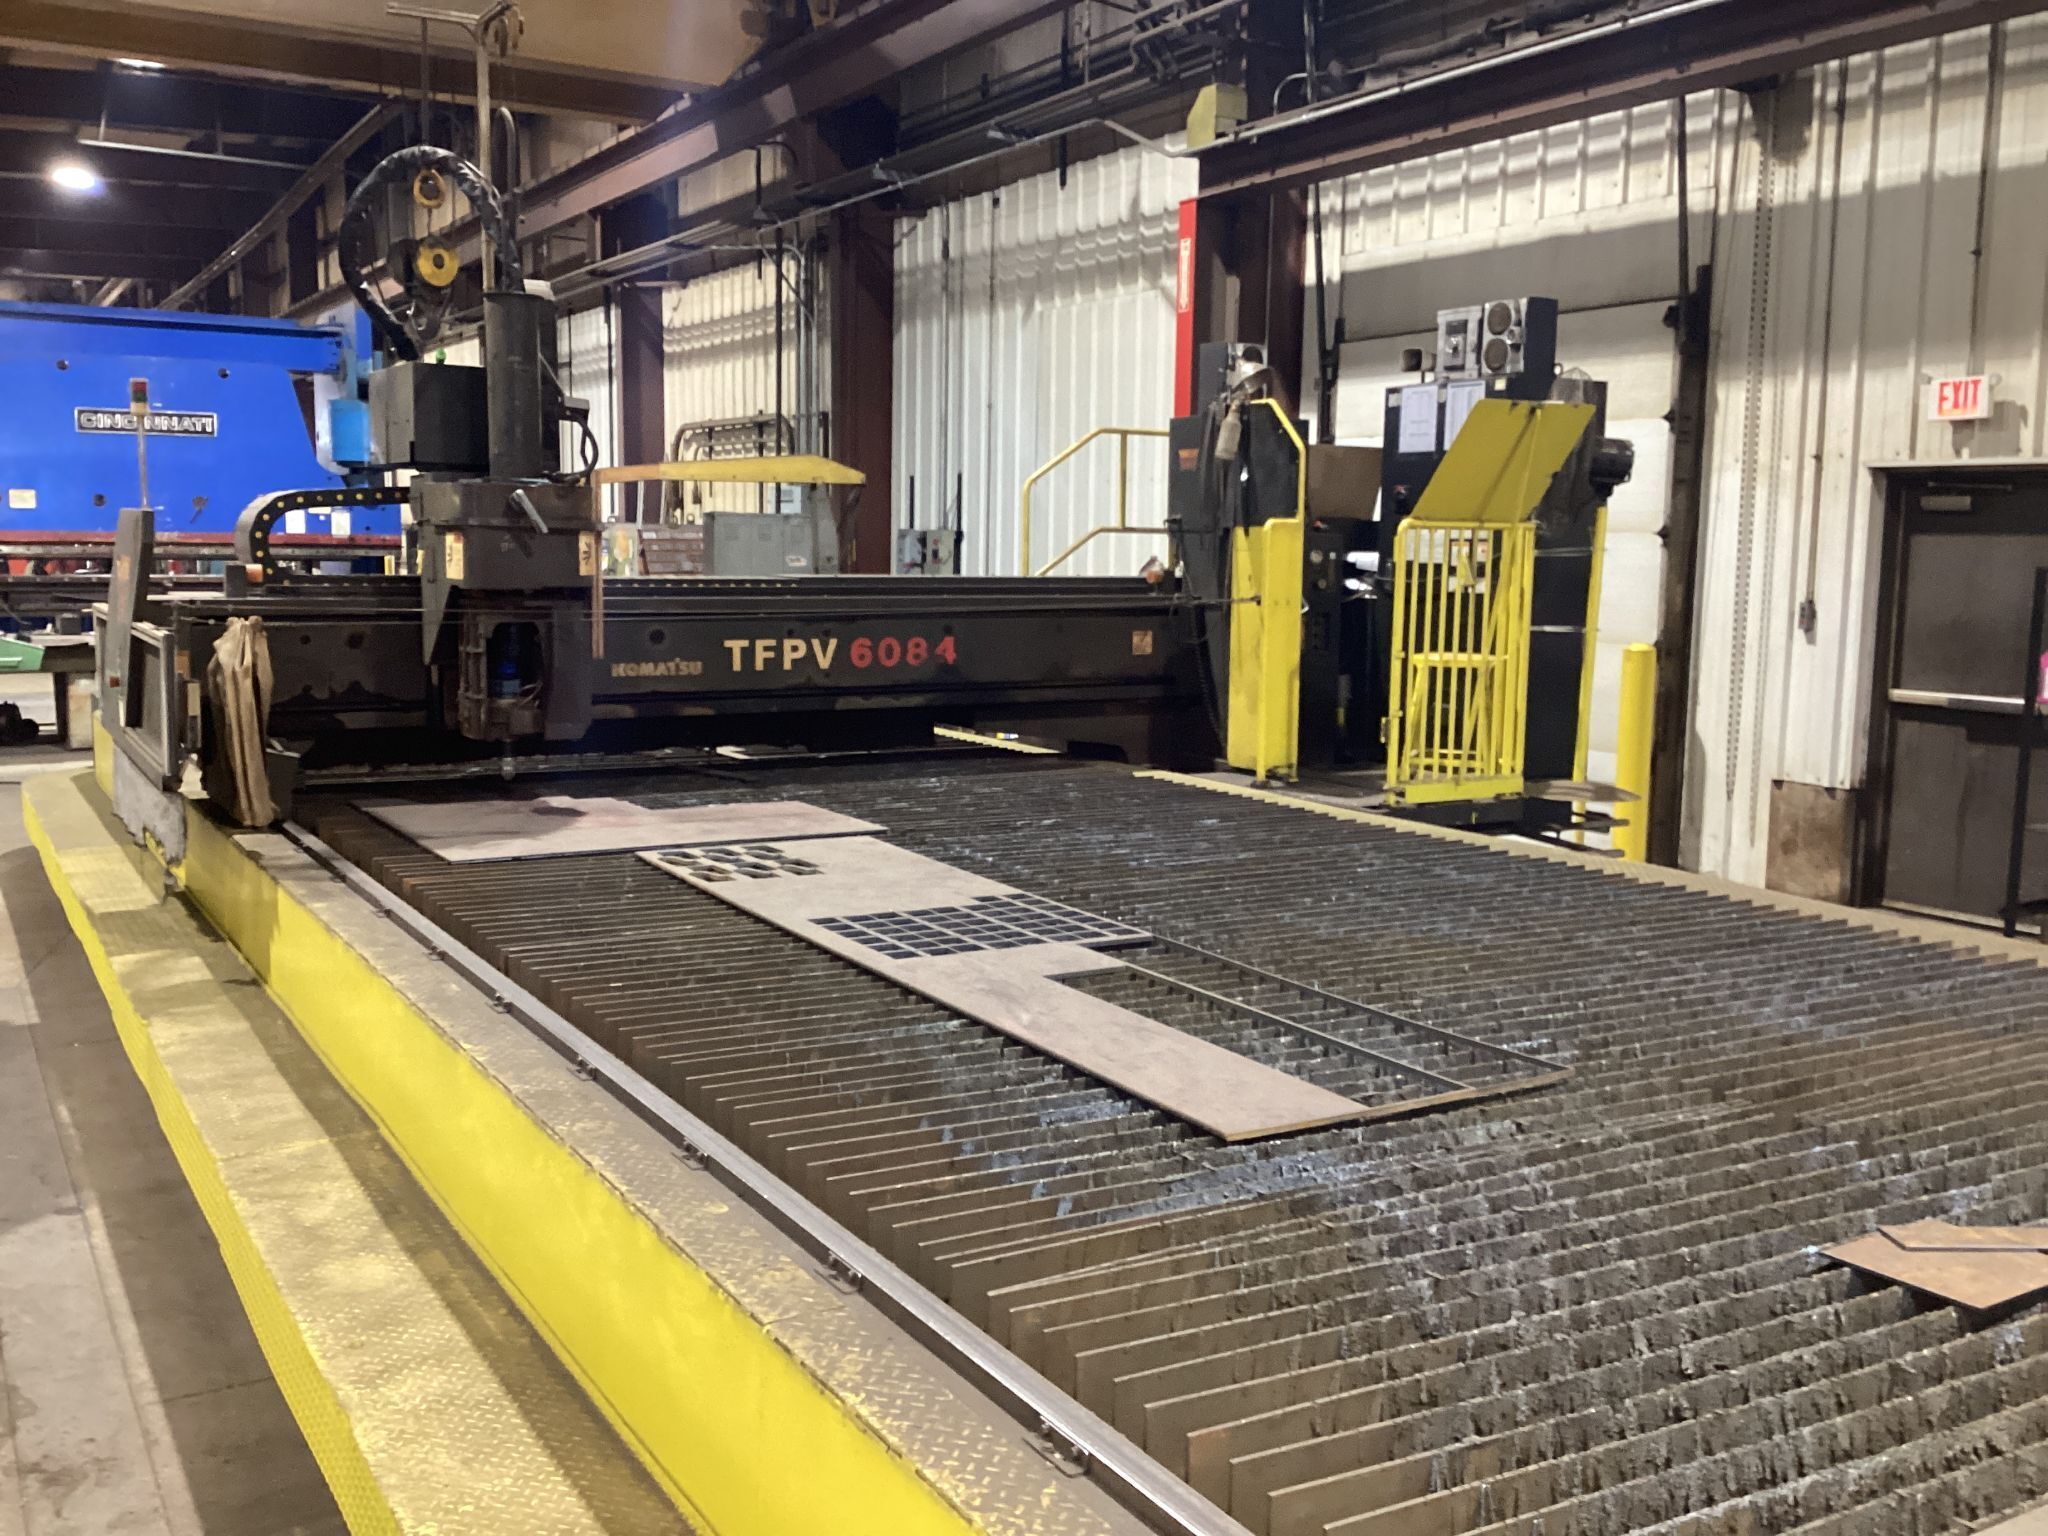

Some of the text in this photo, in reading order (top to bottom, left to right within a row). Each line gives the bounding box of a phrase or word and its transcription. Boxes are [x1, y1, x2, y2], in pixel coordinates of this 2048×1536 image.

[1937, 379, 1981, 416] EXIT
[80, 412, 213, 432] CINCNNATI
[724, 636, 957, 672] TFPV 6084
[611, 660, 703, 677] KOMATSU
